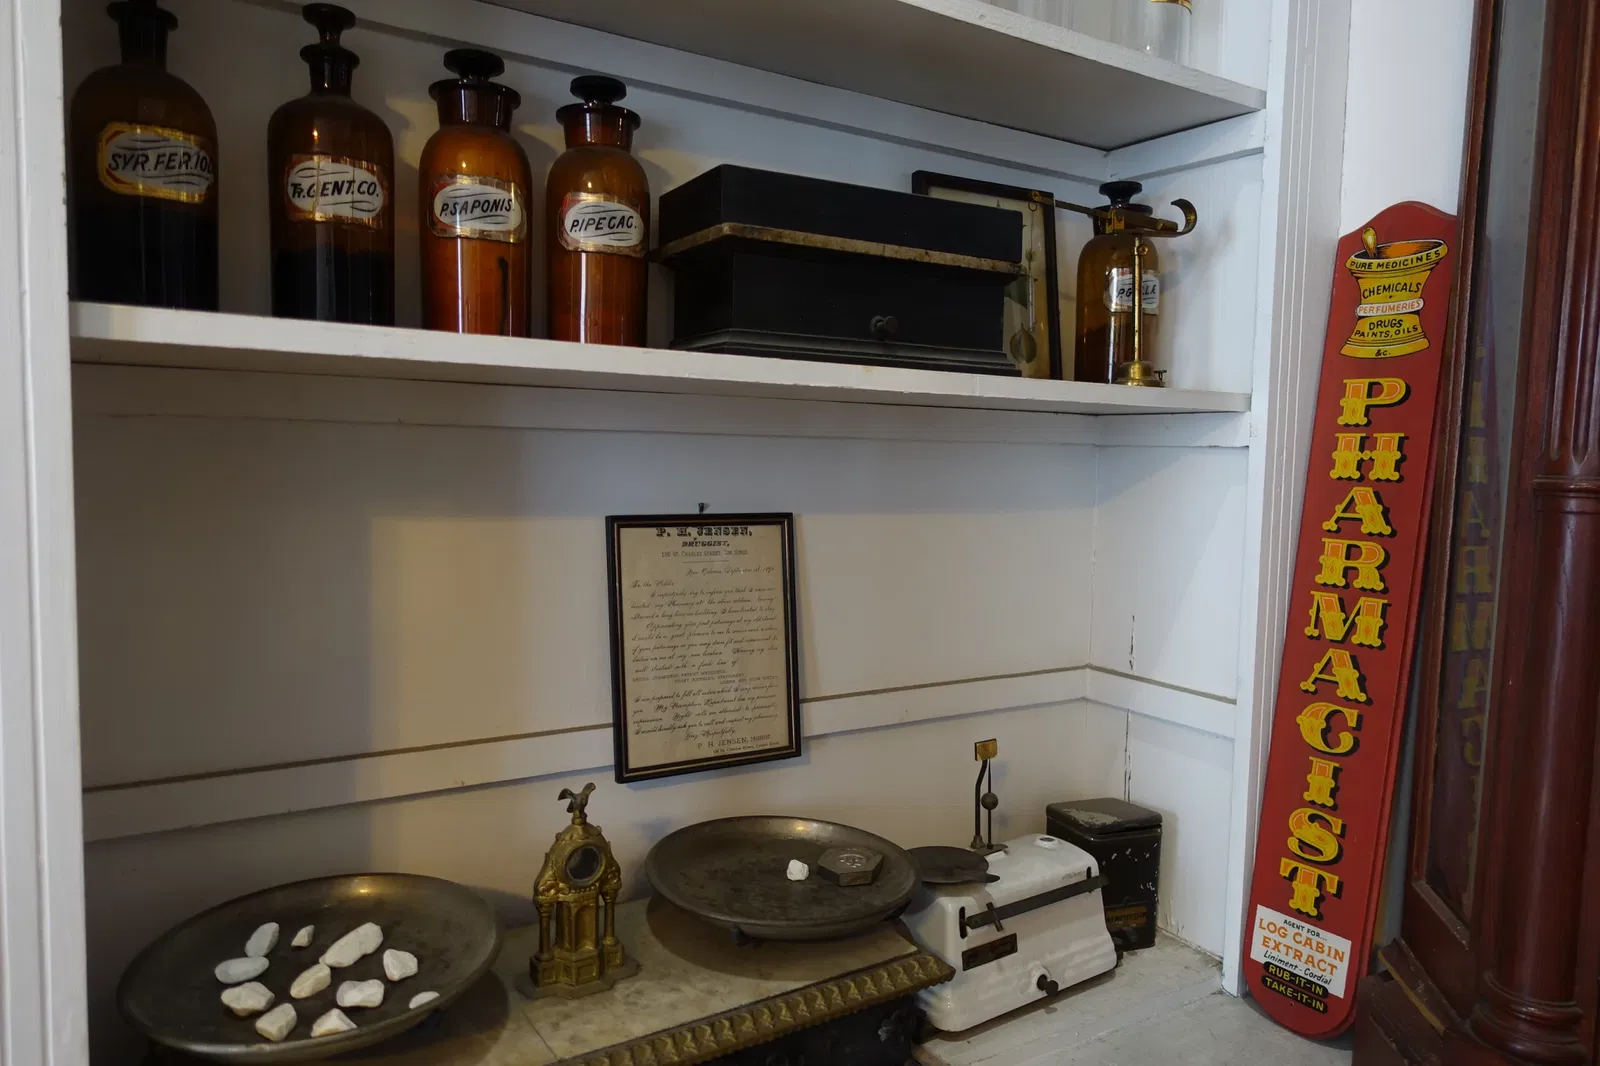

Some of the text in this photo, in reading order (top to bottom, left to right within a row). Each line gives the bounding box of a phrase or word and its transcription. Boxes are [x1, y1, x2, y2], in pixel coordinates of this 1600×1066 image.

[1350, 250, 1442, 270] PURE MEDICINES
[1362, 282, 1422, 299] CHEMICALS
[1358, 300, 1422, 314] PERFUMERIES
[1354, 324, 1418, 338] PAINTS, OILS
[1368, 319, 1404, 331] DRUGS
[1279, 377, 1410, 923] PHARMACIST
[1283, 918, 1306, 932] AGENT
[1258, 918, 1345, 964] LOG CABIN
[1261, 936, 1338, 977] EXTRACT
[1264, 950, 1299, 970] Liniment
[1304, 967, 1333, 986] Cordial
[1268, 964, 1324, 996] RUB-IT-IN
[1265, 977, 1325, 1012] TAKE-IT-IN
